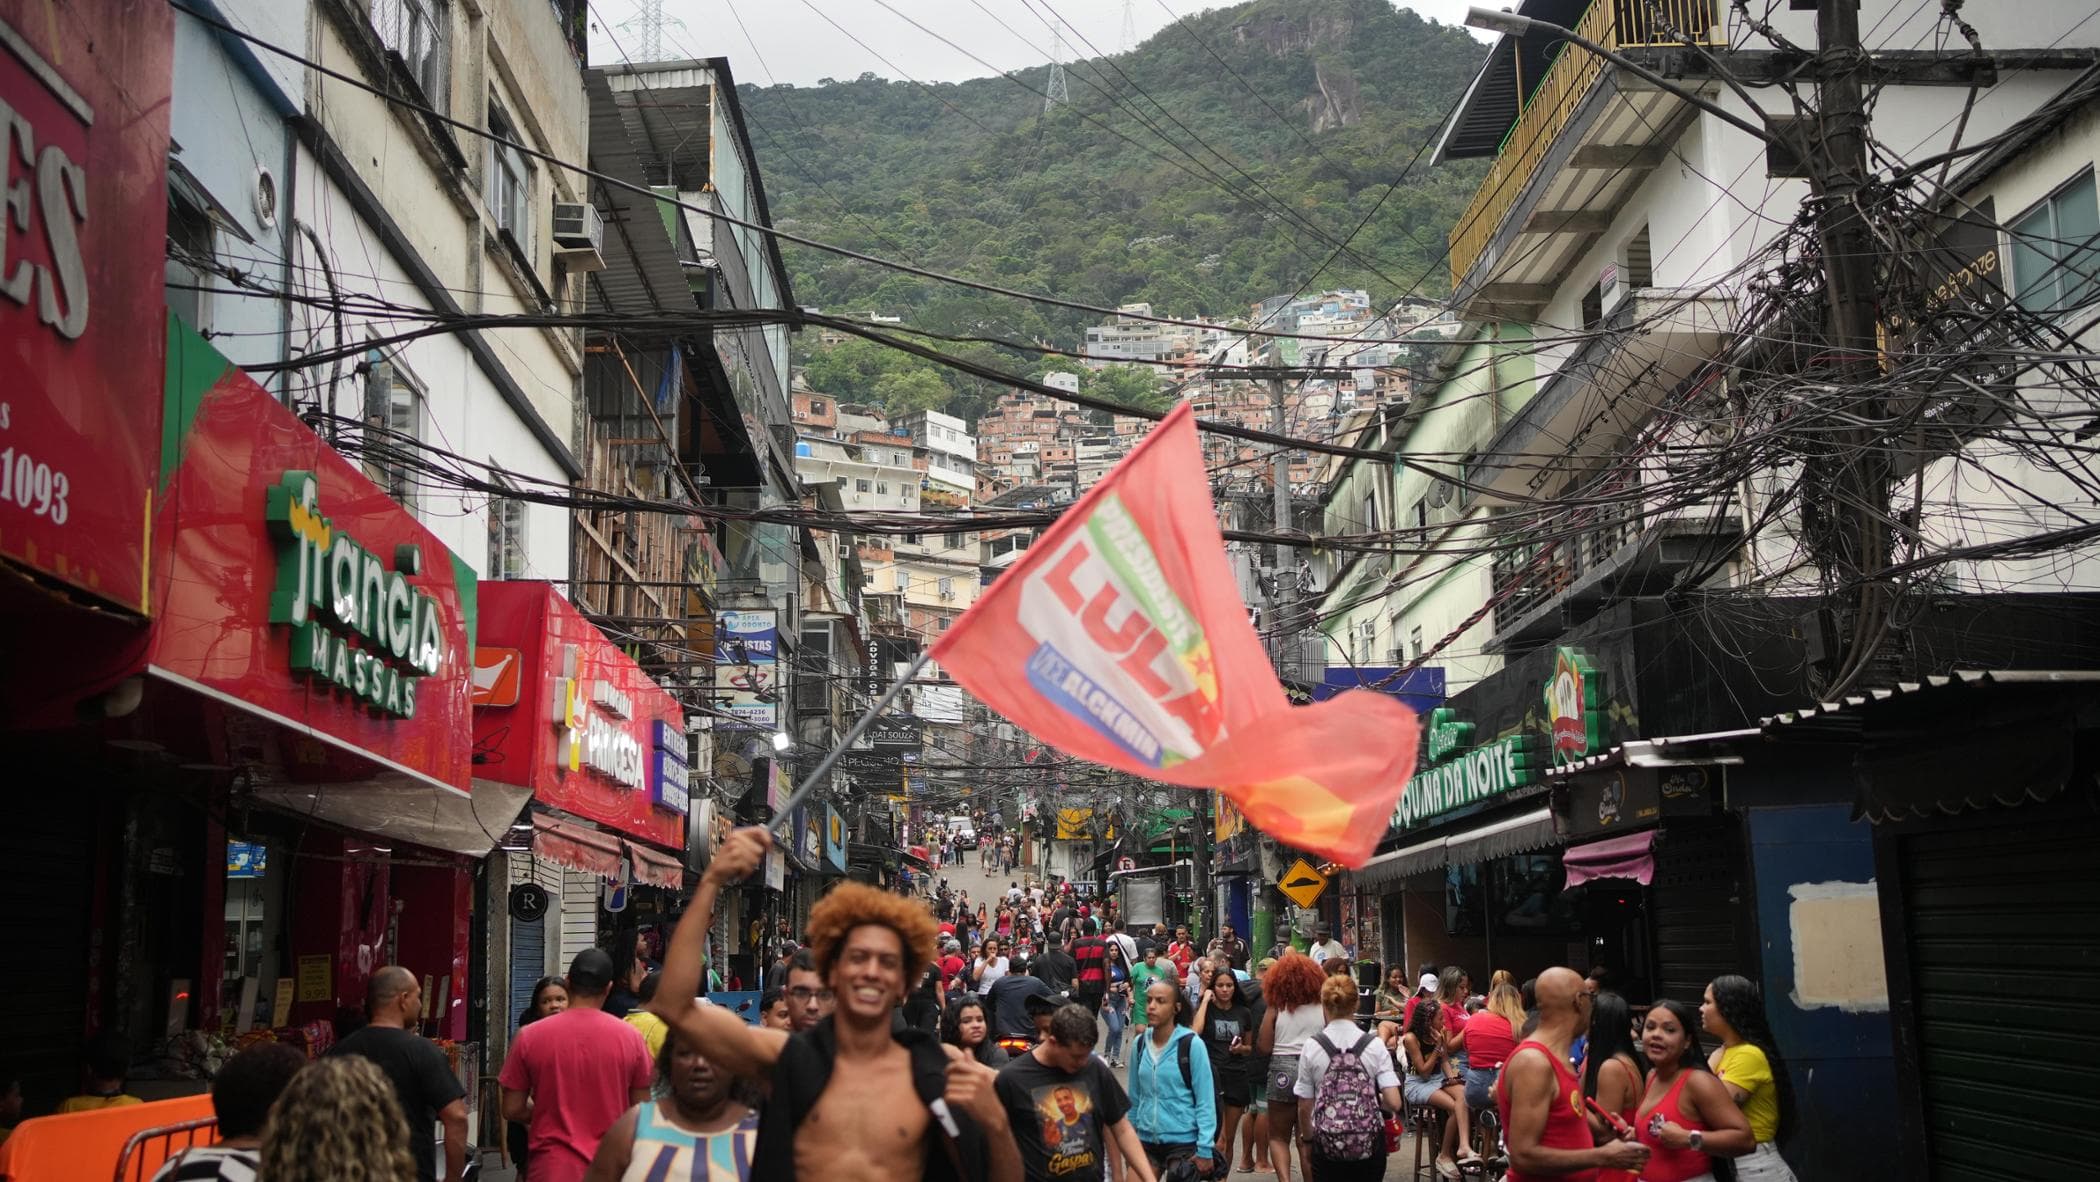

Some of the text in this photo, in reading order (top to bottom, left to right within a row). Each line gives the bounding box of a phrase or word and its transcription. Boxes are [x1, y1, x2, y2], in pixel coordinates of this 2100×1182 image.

[0, 446, 69, 525] 1093
[312, 624, 415, 717] MASSAS
[869, 641, 878, 695] ADVOGAOS
[888, 731, 914, 739] SOUZA
[1389, 739, 1516, 829] SQUINA DA NOITE
[523, 892, 536, 909] R
